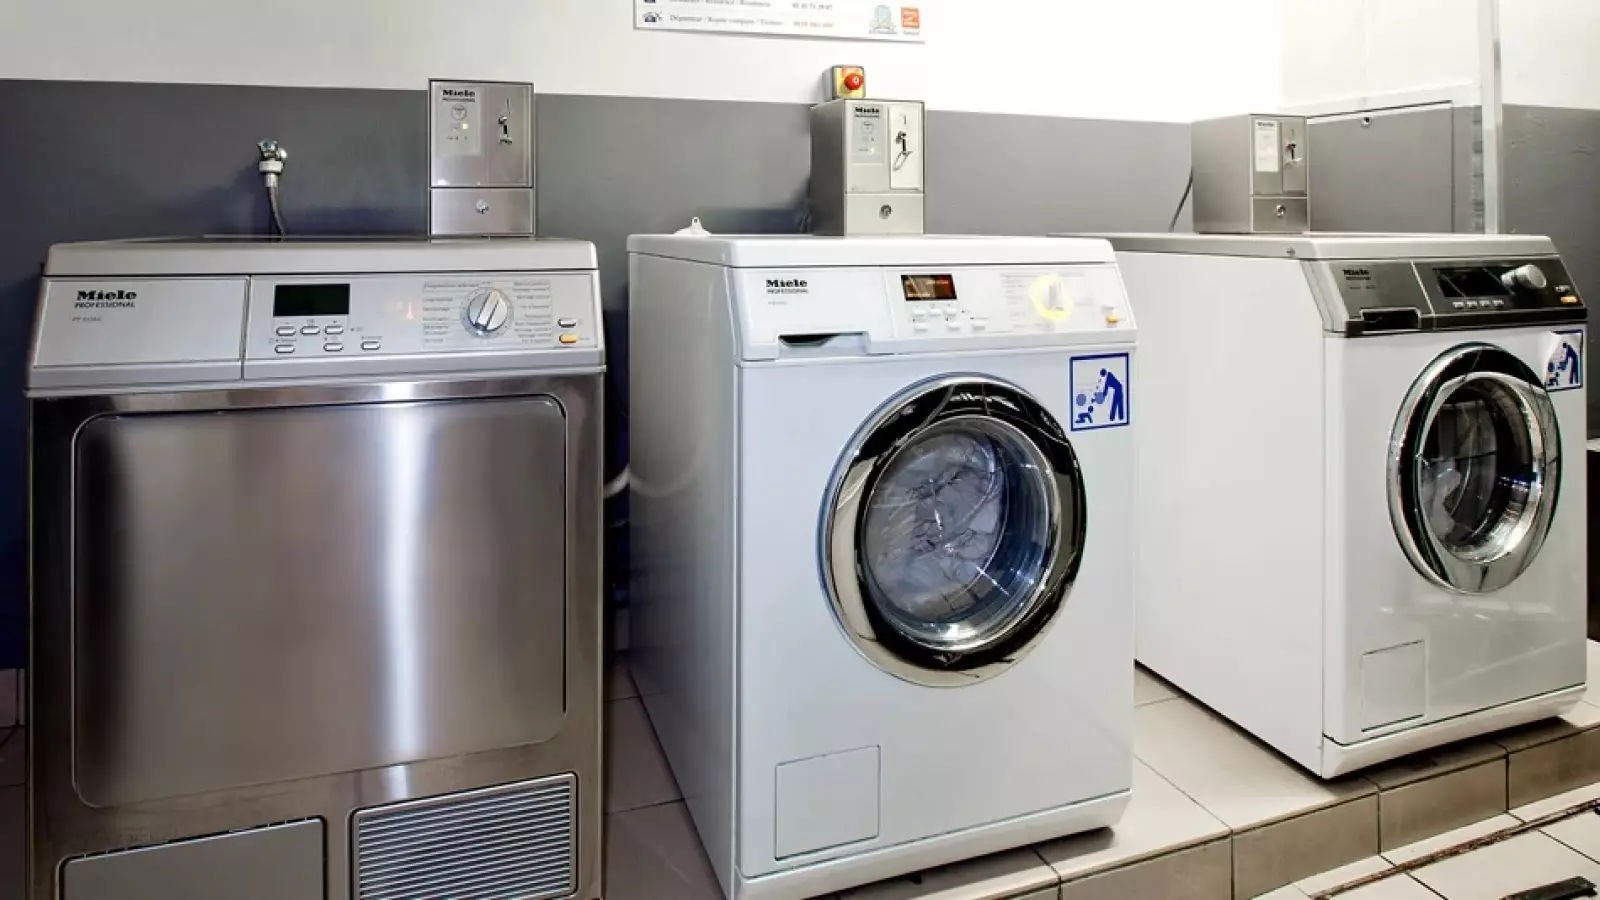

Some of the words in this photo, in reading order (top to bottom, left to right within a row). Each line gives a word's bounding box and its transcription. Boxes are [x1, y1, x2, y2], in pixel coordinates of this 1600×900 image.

[442, 89, 476, 97] Miele
[855, 106, 880, 114] Miele
[765, 278, 808, 288] Miele
[76, 289, 137, 300] Miele
[74, 301, 136, 309] PROFESSIONAL
